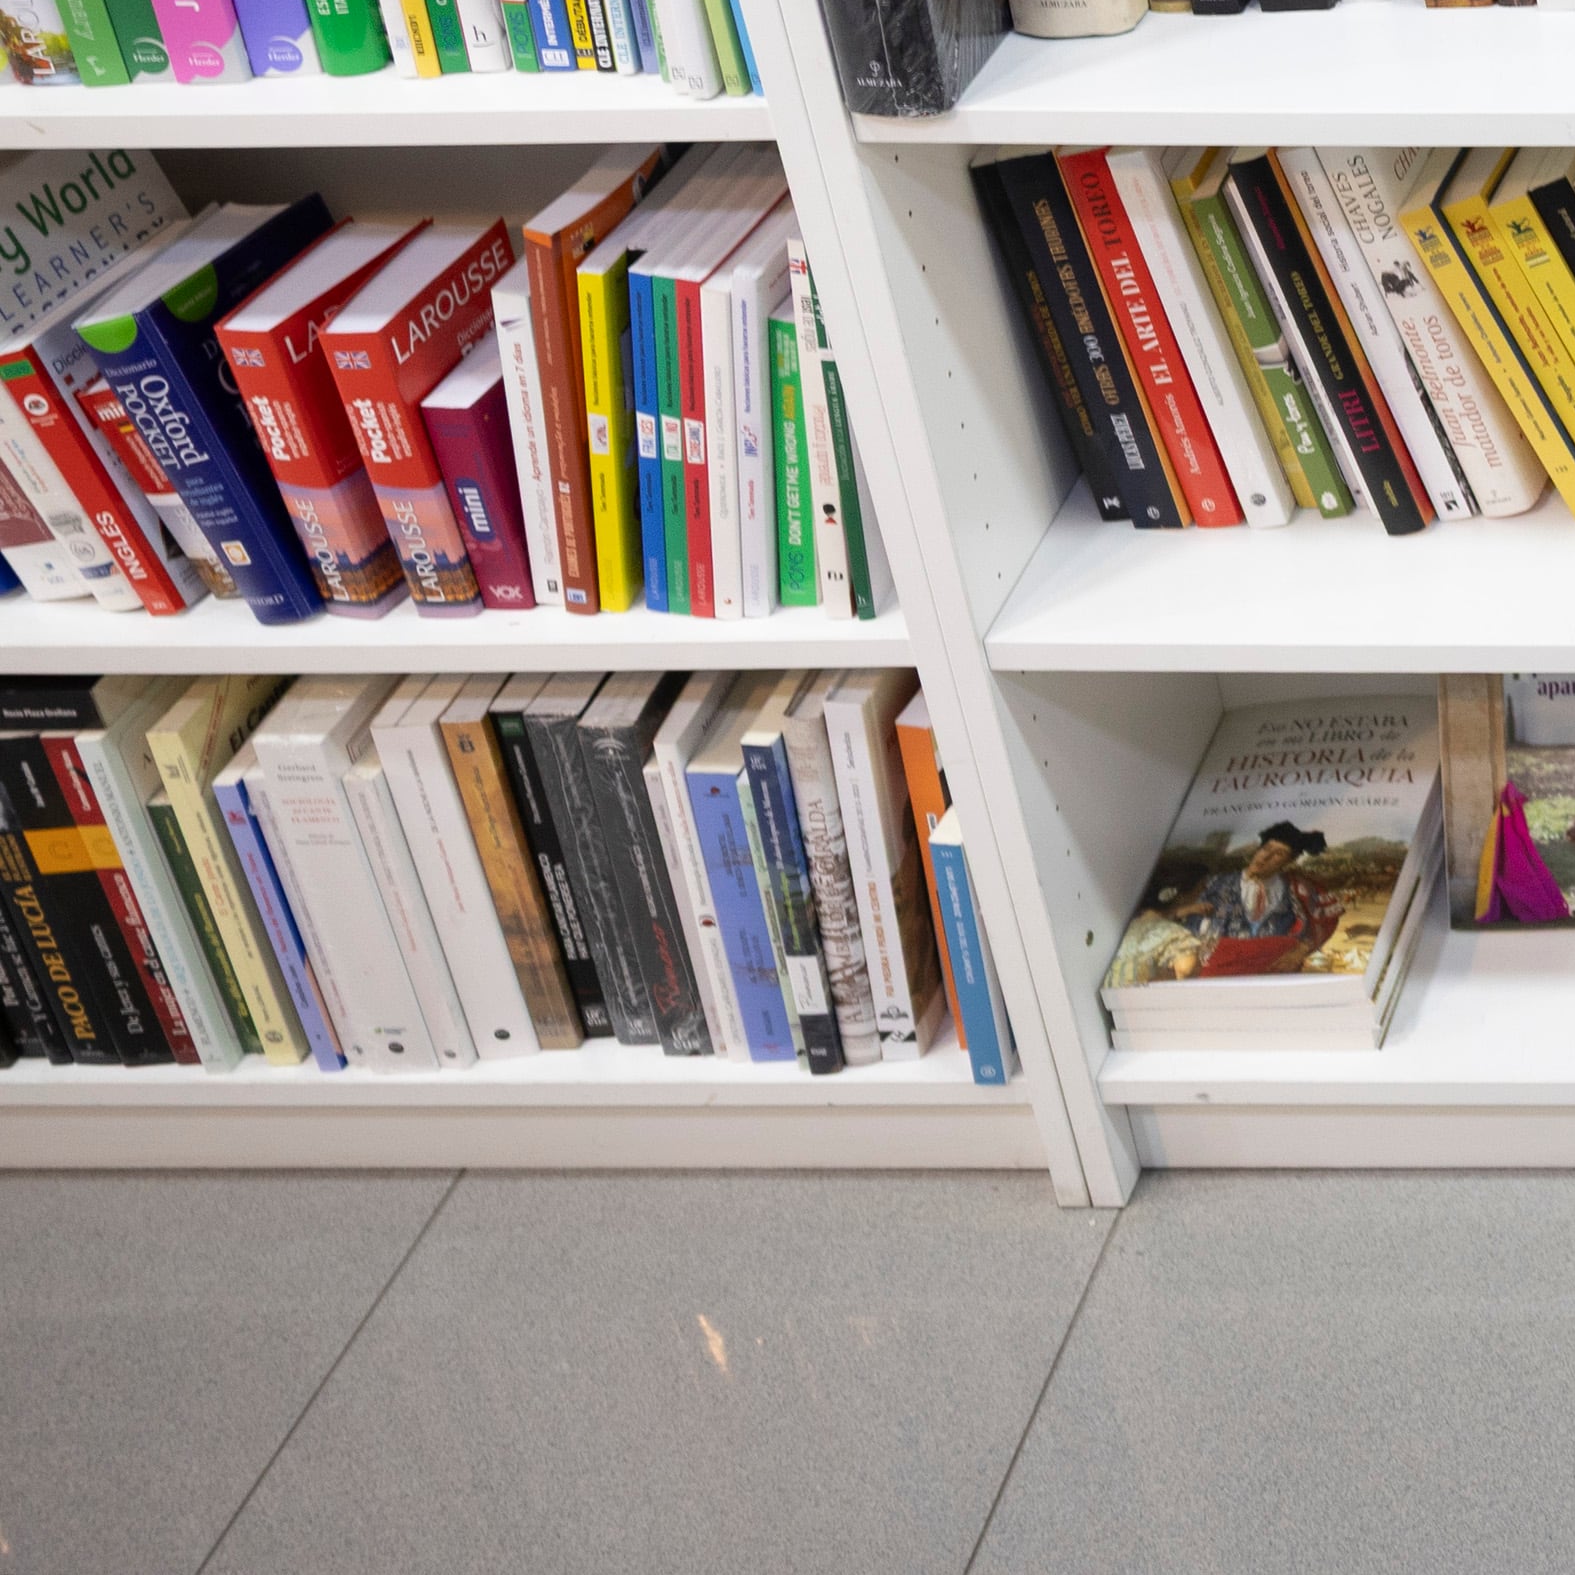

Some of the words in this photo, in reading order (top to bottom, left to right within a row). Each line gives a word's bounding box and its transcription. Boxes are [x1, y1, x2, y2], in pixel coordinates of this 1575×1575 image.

[16, 149, 138, 234] World
[1080, 172, 1124, 249] TOREO
[1331, 171, 1375, 245] CHAVES
[1349, 153, 1398, 242] NOGALES
[0, 190, 157, 323] LEARNER'S
[1110, 255, 1141, 299] DEL
[389, 239, 509, 366] LAROUSSE
[1131, 303, 1162, 360] ARTE
[1150, 363, 1174, 386] EL
[115, 383, 180, 470] POCKET
[138, 374, 210, 468] Oxford
[248, 395, 291, 463] Pocket
[1338, 389, 1380, 455] LITRI
[457, 485, 492, 534] mini
[95, 511, 148, 581] INGLÉS
[397, 499, 446, 604] LAROUSSE
[13, 884, 58, 950] LUCÍA
[42, 952, 73, 983] DE
[57, 986, 97, 1041] PACO
